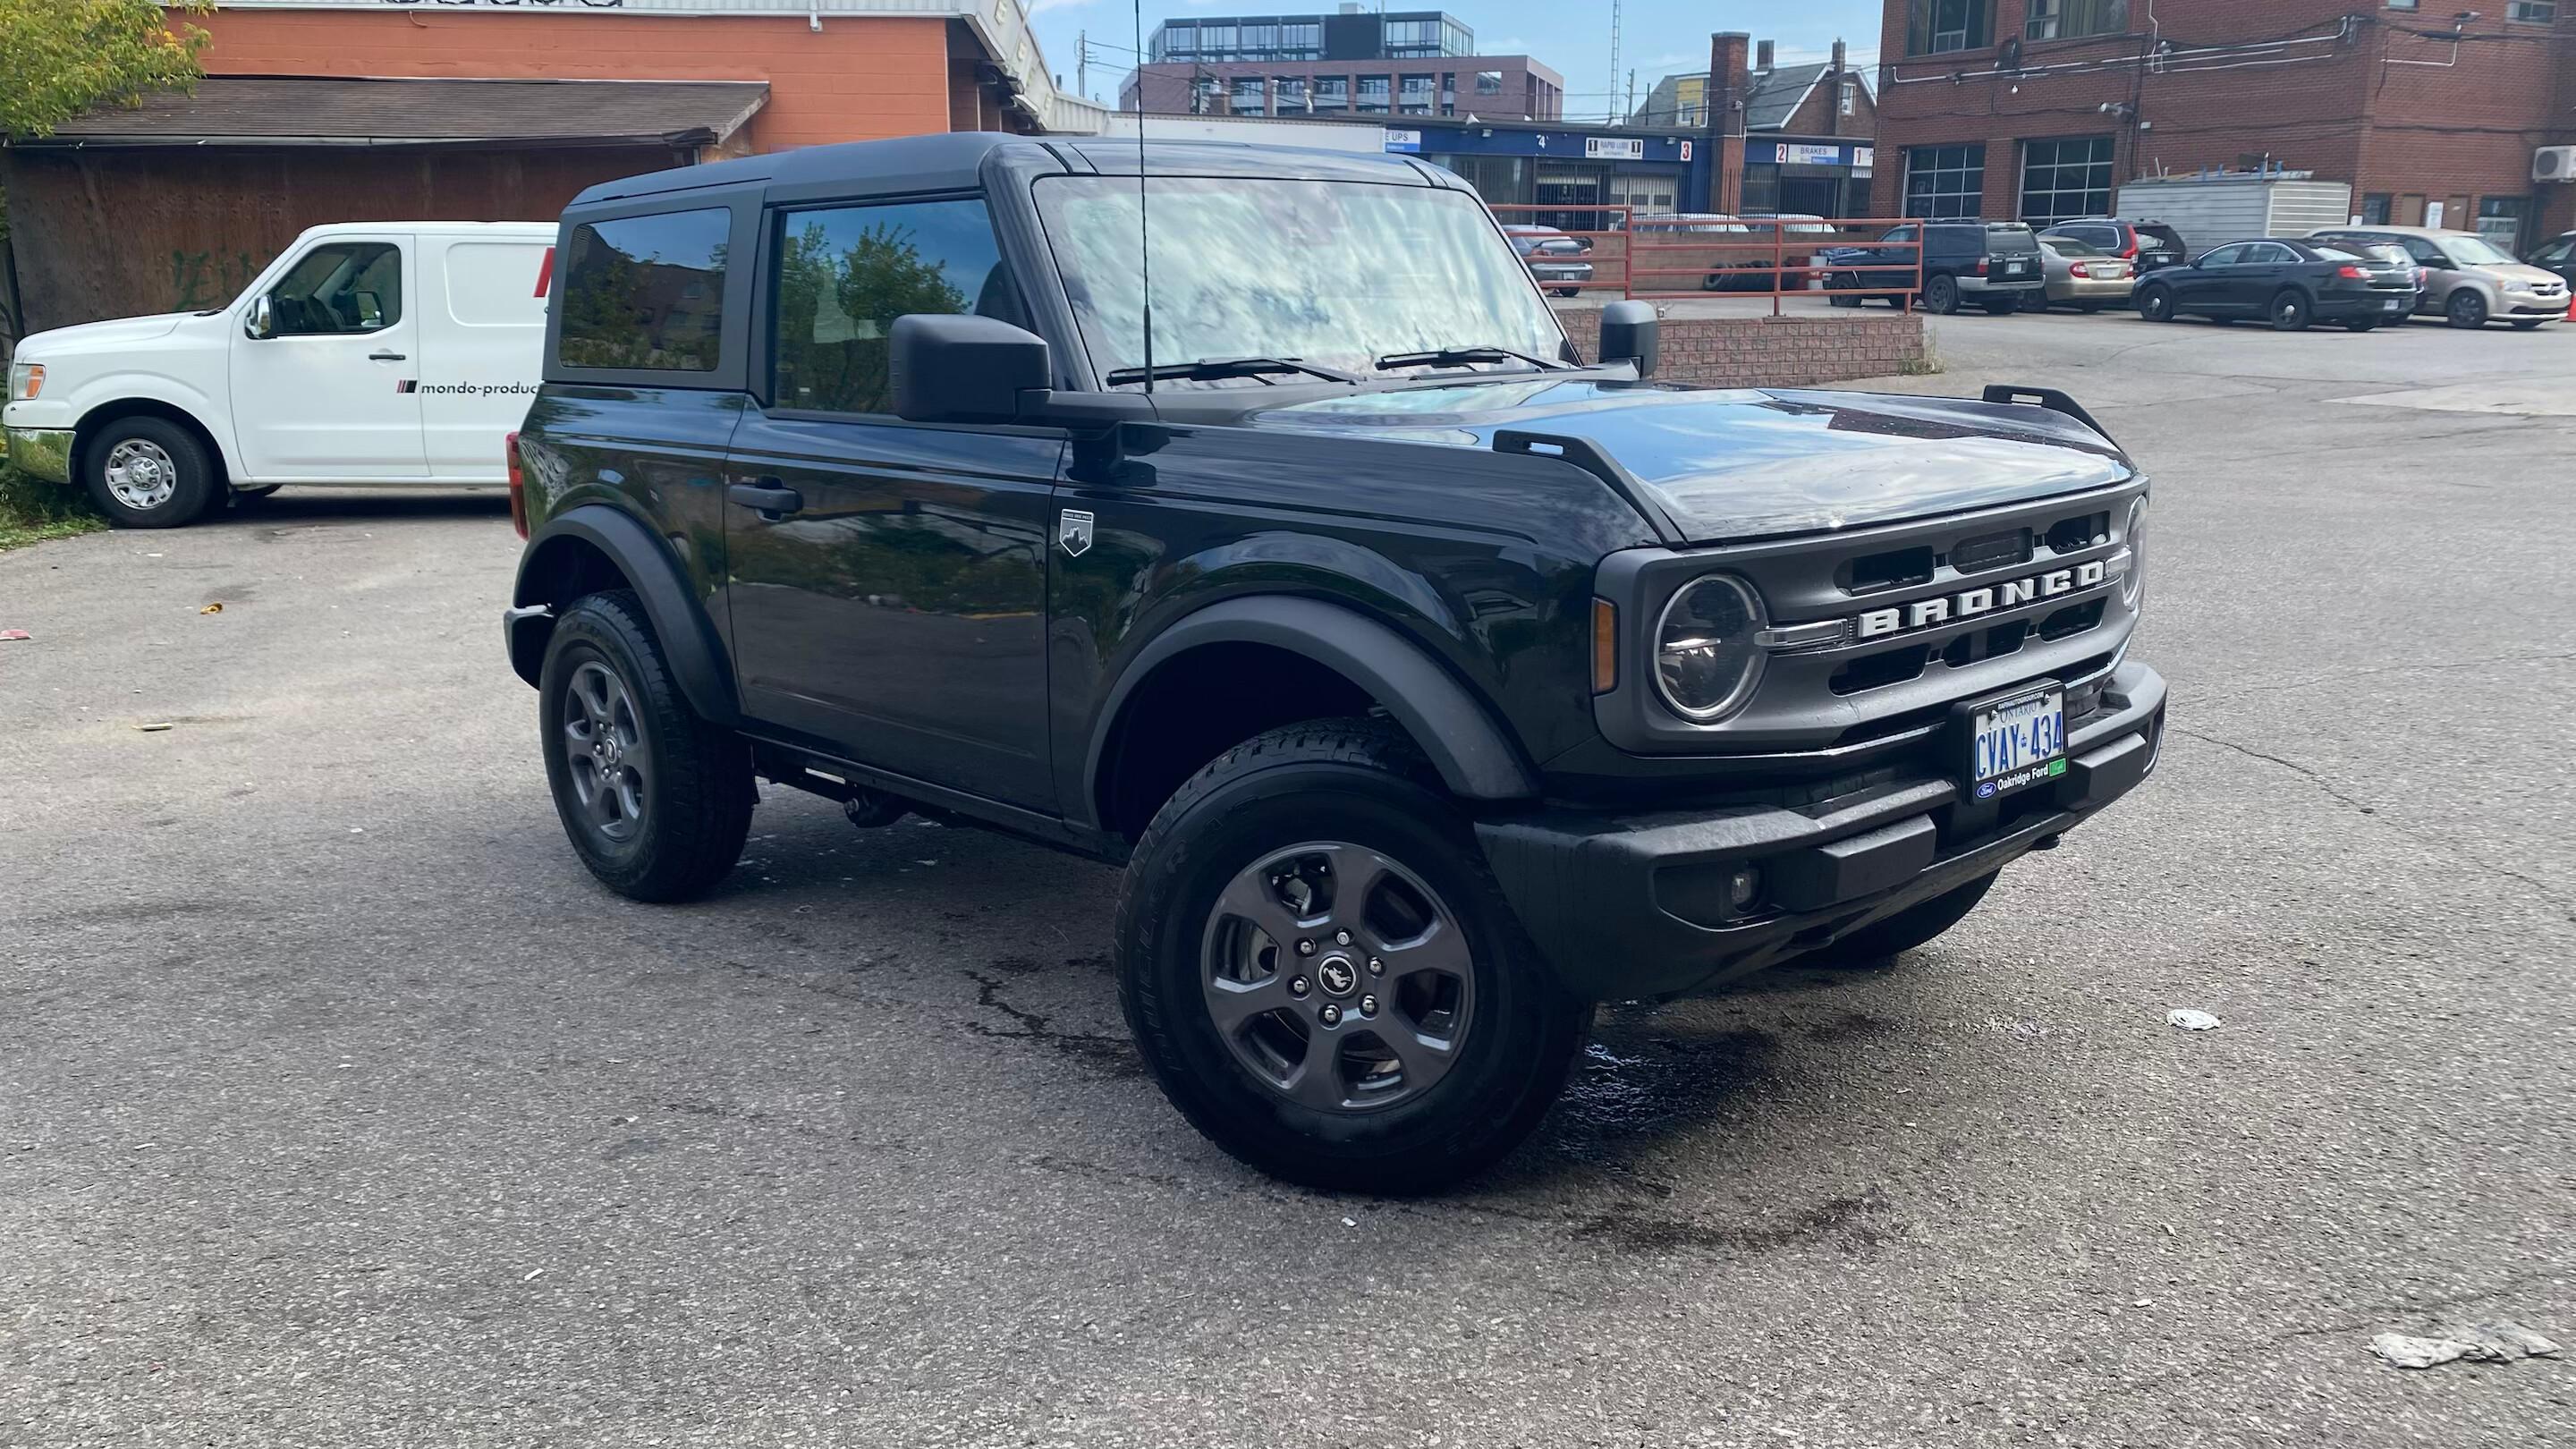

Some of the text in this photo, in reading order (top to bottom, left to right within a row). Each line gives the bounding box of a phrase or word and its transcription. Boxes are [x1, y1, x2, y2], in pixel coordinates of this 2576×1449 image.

[1392, 133, 1409, 141] UPS
[1682, 143, 1690, 159] 3
[1777, 145, 1785, 161] 2
[1801, 147, 1827, 156] BRAKES
[1856, 148, 1861, 164] 1
[421, 381, 539, 397] mondo-produc
[1858, 560, 2104, 638] BRONCO
[2000, 702, 2038, 723] ONTARIO
[1976, 710, 2062, 778] CVAY 434
[1997, 774, 2030, 791] Oakridge
[2031, 764, 2048, 779] Ford
